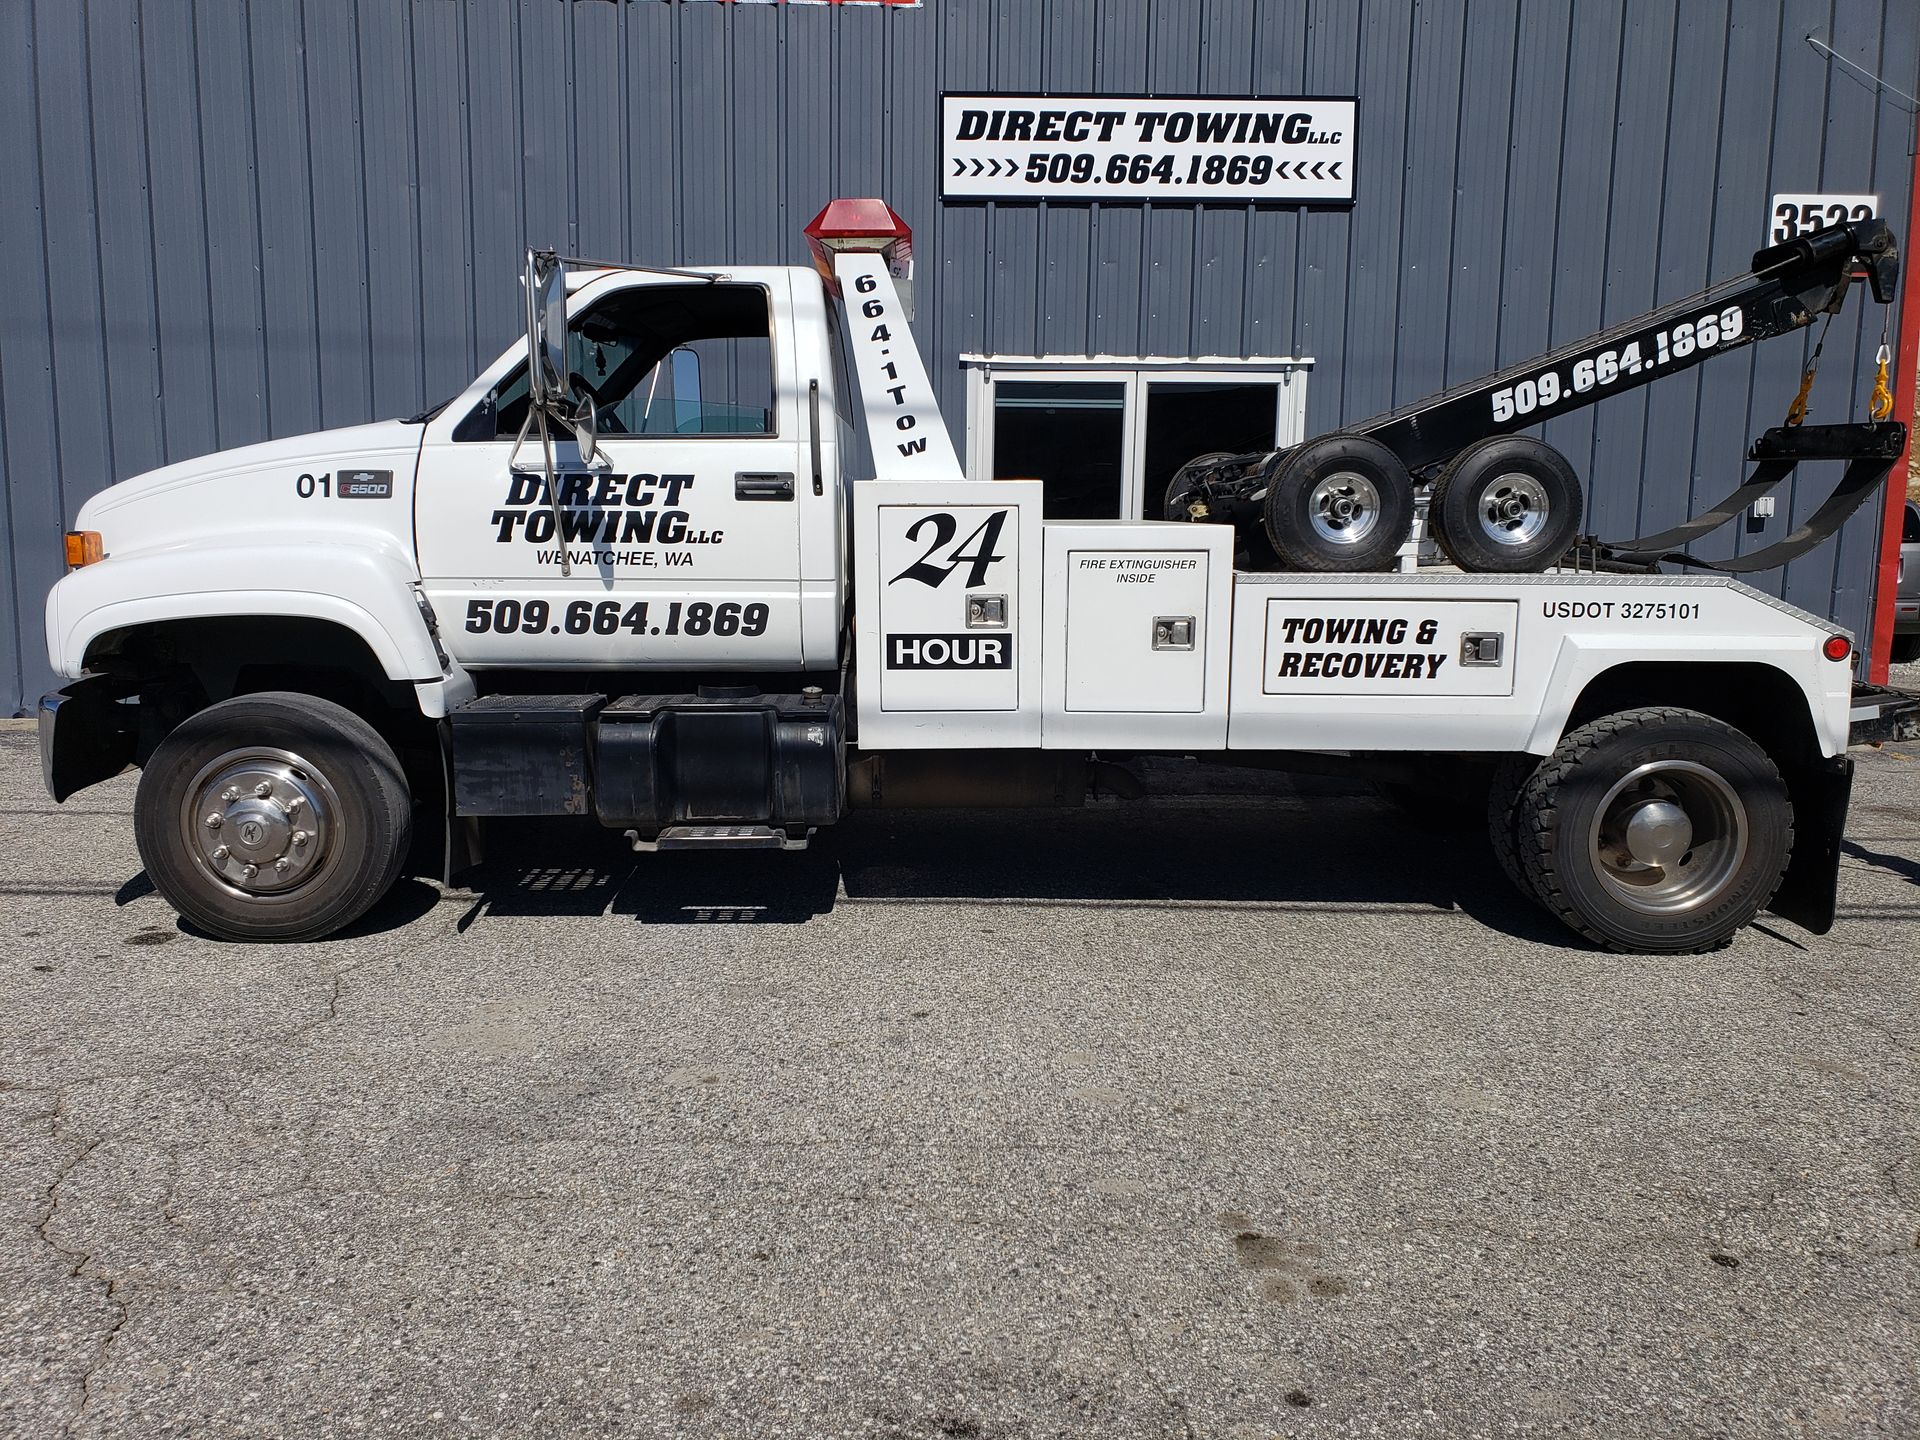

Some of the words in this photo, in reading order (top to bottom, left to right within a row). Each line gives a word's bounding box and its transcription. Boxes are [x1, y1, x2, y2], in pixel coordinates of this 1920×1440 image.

[956, 109, 1127, 142] DIRECT
[1135, 111, 1311, 145] TOWING
[1025, 153, 1274, 186] 509.664.1869
[1491, 305, 1743, 423] 509.664.1869
[340, 484, 388, 495] C6500
[505, 474, 695, 506] DIRECT
[491, 510, 690, 544] TOWING
[536, 550, 658, 568] WENATCHEE,
[664, 552, 694, 567] WA
[888, 510, 1009, 589] 24
[1079, 559, 1107, 570] FIRE
[1109, 559, 1197, 570] EXTINGUISHER
[1116, 573, 1156, 584] INSIDE
[465, 600, 770, 637] 509.664.1869
[1542, 602, 1615, 619] USDOT
[1620, 603, 1700, 620] 3275101
[1282, 618, 1409, 645] TOWING
[1415, 619, 1439, 645] &
[895, 638, 1003, 665] HOUR
[1278, 652, 1448, 679] RECOVERY
